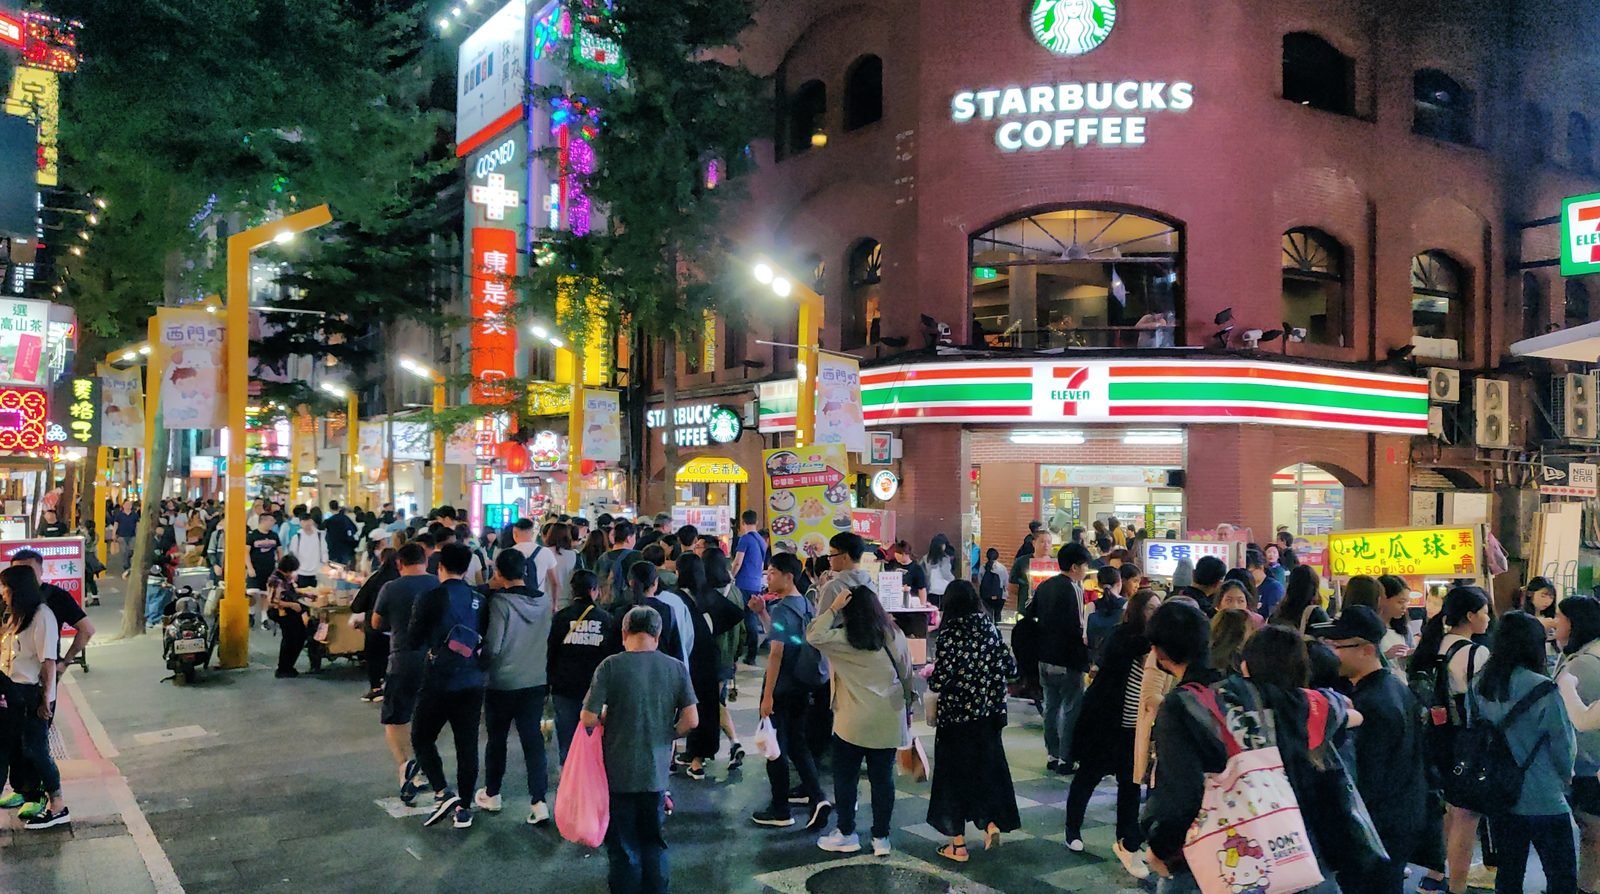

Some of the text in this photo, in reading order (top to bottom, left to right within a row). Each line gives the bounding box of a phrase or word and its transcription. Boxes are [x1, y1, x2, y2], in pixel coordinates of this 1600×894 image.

[953, 82, 1193, 121] STARBUCKS
[997, 117, 1146, 149] COFFEE
[476, 139, 515, 178] COSMED
[482, 250, 508, 335] 康是美
[1, 317, 42, 332] 高山茶
[166, 326, 226, 342] 西門町
[646, 403, 719, 429] STRBUCK
[662, 427, 708, 446] FFEE
[1352, 533, 1449, 559] 地瓜球
[570, 620, 602, 634] PEACE
